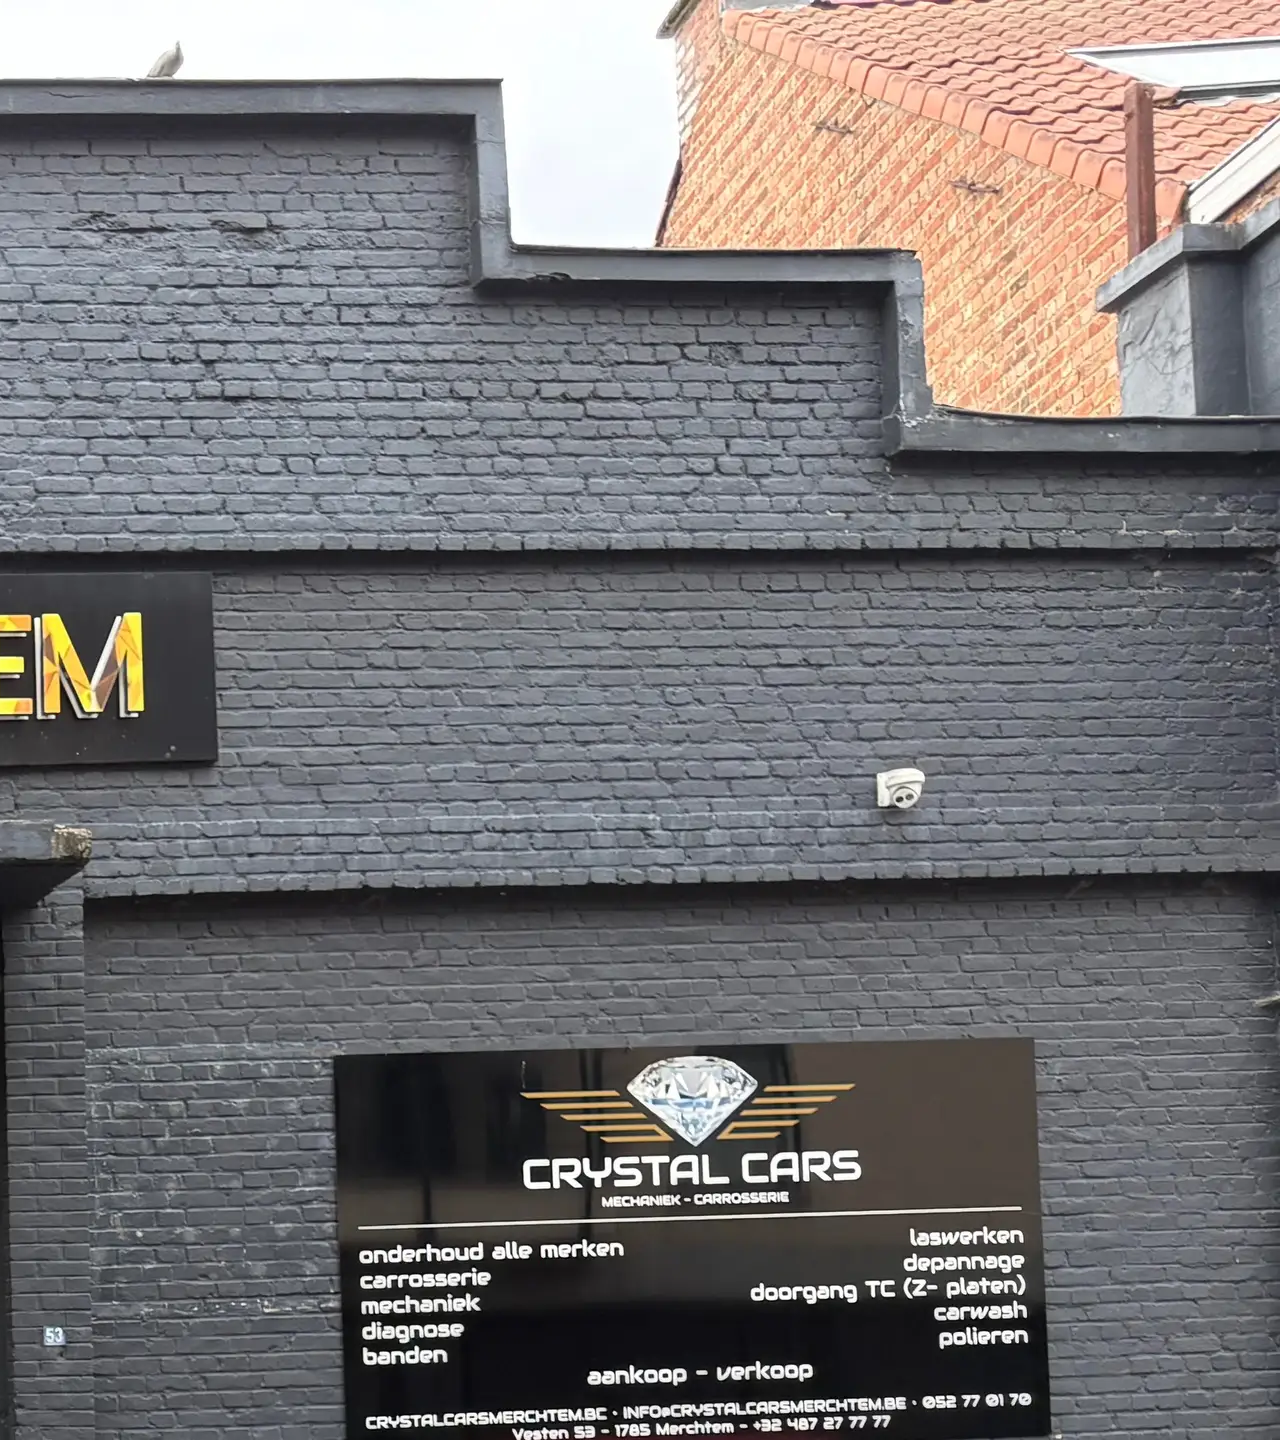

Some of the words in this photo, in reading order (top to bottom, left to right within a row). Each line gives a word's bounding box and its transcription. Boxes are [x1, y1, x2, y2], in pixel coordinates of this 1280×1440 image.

[522, 1154, 730, 1190] CRYSTAL
[741, 1149, 862, 1184] CARS
[601, 1194, 682, 1208] MECHANIEK
[693, 1191, 790, 1205] CARROSSERIE
[909, 1225, 1024, 1247] laswerken
[358, 1241, 484, 1264] onderhoud
[491, 1240, 533, 1260] alle
[540, 1238, 625, 1259] merken
[903, 1253, 1025, 1275] depannage
[359, 1267, 492, 1290] carrosserie
[750, 1282, 858, 1305] doorgang
[864, 1279, 896, 1298] TC
[946, 1273, 1026, 1299] platen)
[360, 1292, 481, 1315] mechaniek
[933, 1300, 1028, 1321] carwash
[45, 1326, 63, 1343] 53
[361, 1321, 465, 1344] diagnose
[938, 1326, 1029, 1350] polieren
[362, 1345, 448, 1366] banden
[586, 1364, 688, 1387] aankoop
[716, 1360, 814, 1382] verkoop
[922, 1394, 957, 1409] 052
[961, 1394, 981, 1408] 77
[985, 1393, 1004, 1407] 01
[1008, 1392, 1032, 1407] 70
[511, 1427, 570, 1440] Vesten
[573, 1425, 596, 1439] 53
[614, 1423, 651, 1438] 1785
[655, 1420, 735, 1436] Merchtem
[752, 1418, 783, 1432] +32
[786, 1417, 819, 1431] 487
[822, 1416, 844, 1430] 27
[847, 1415, 868, 1429] 77
[871, 1414, 892, 1428] 77
